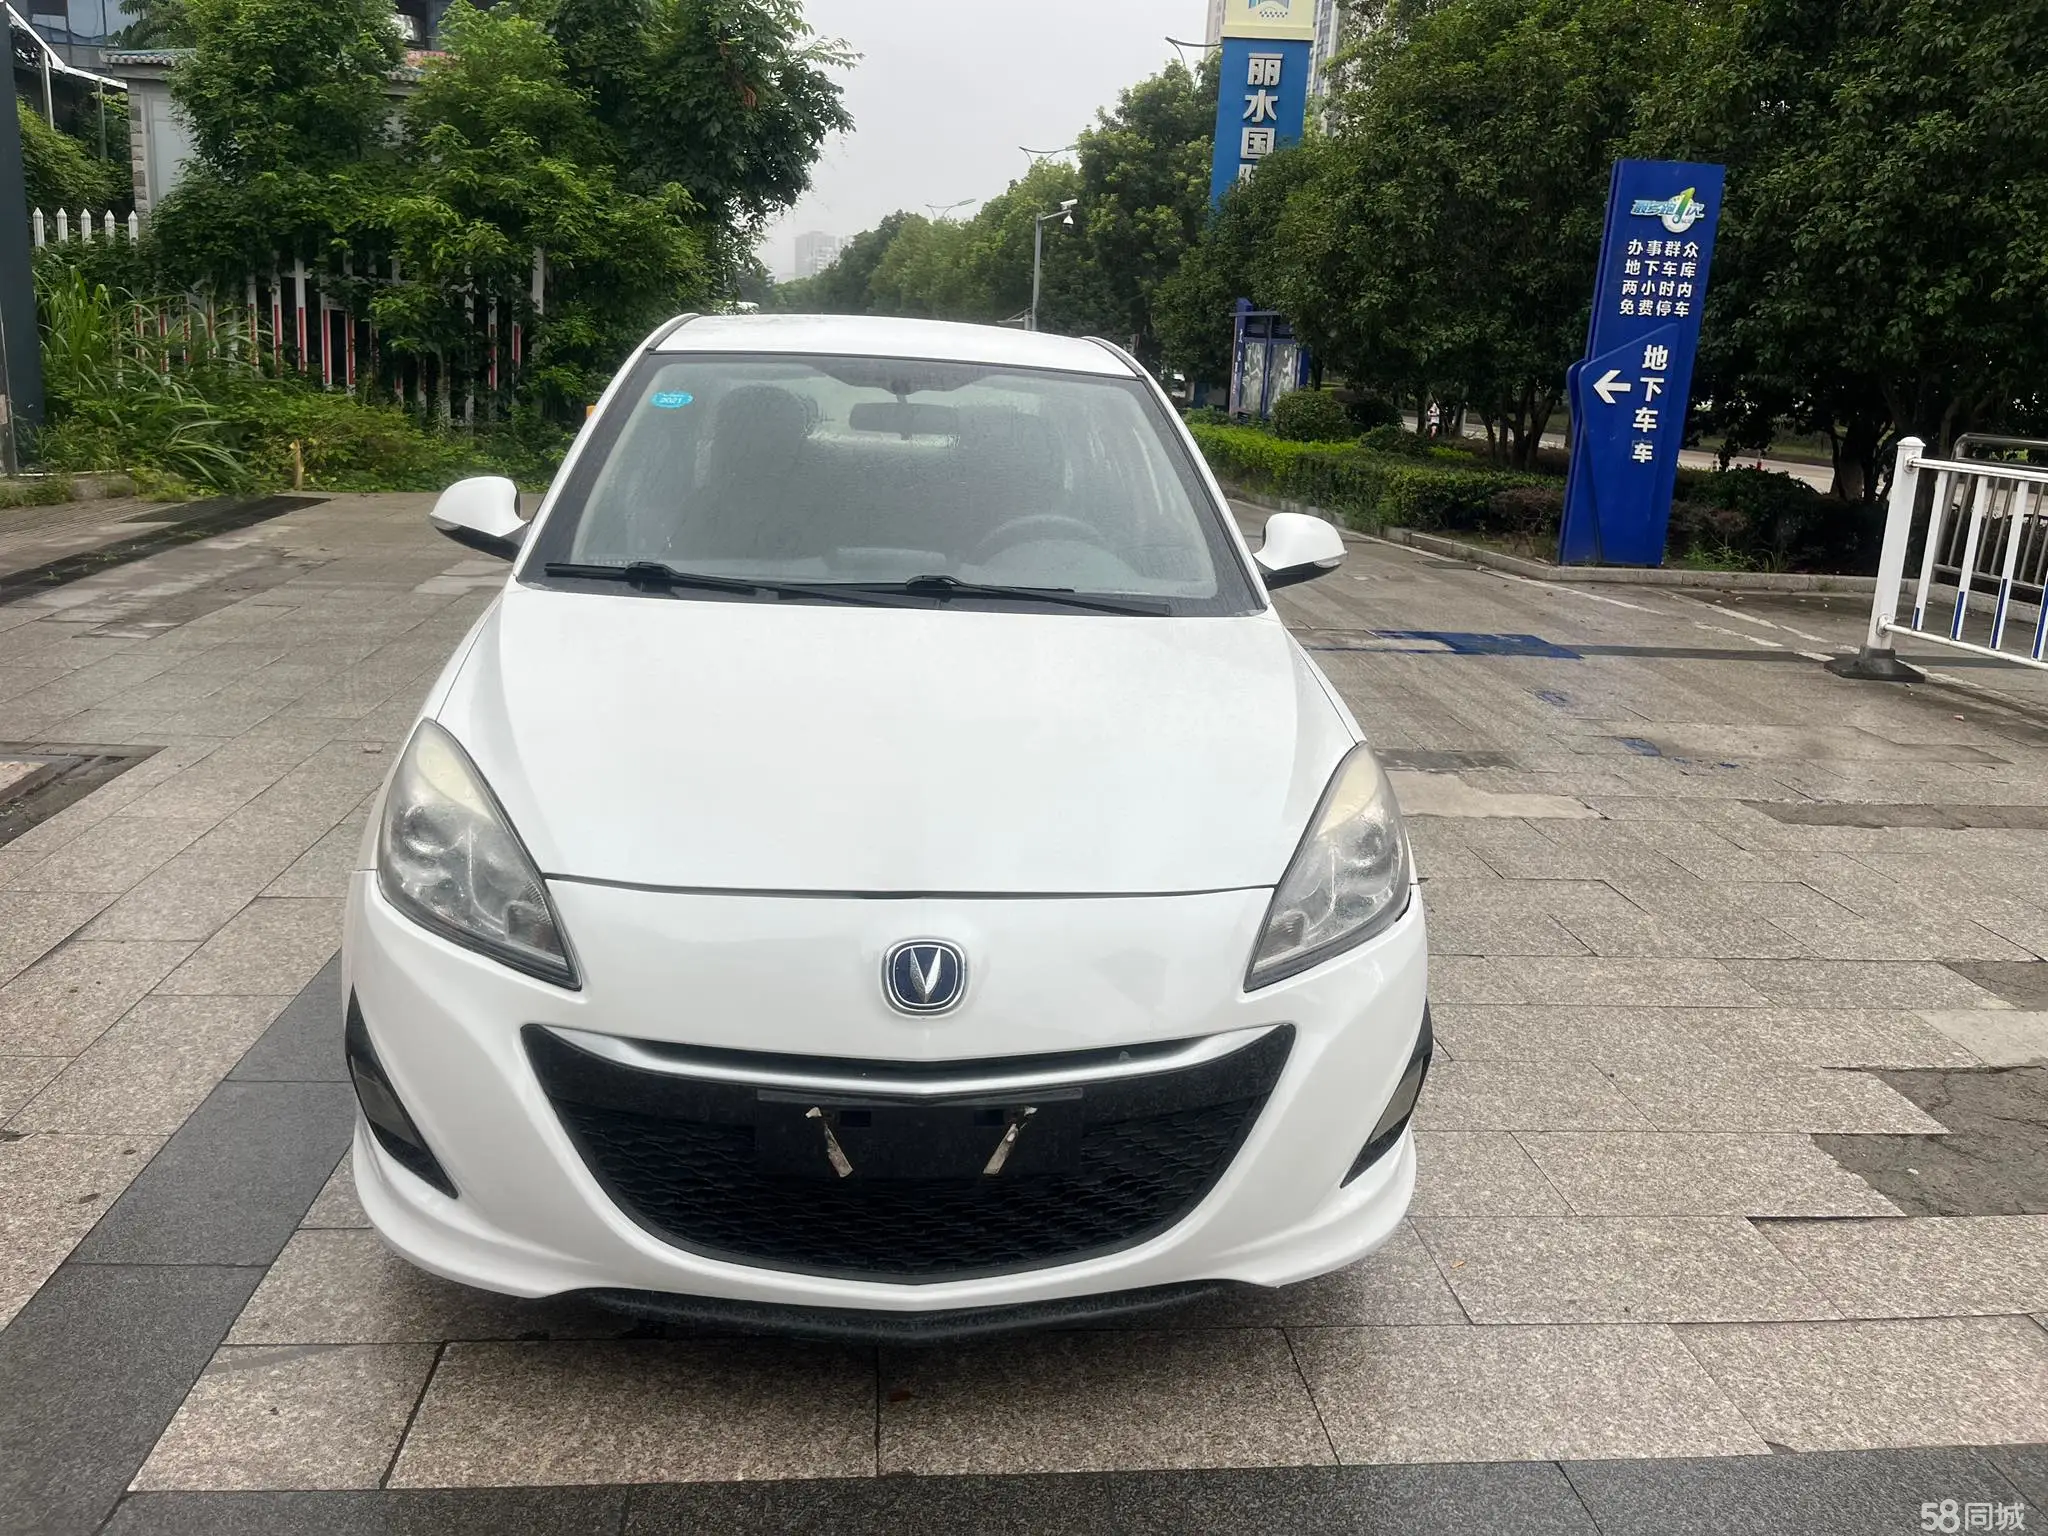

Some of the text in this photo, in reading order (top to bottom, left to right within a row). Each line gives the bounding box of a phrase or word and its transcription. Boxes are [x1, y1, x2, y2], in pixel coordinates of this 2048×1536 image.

[1627, 239, 1699, 258] 办事群众
[1624, 259, 1697, 278] 地下车库
[1621, 280, 1692, 298] 两小时内
[1619, 299, 1690, 317] 免费停车
